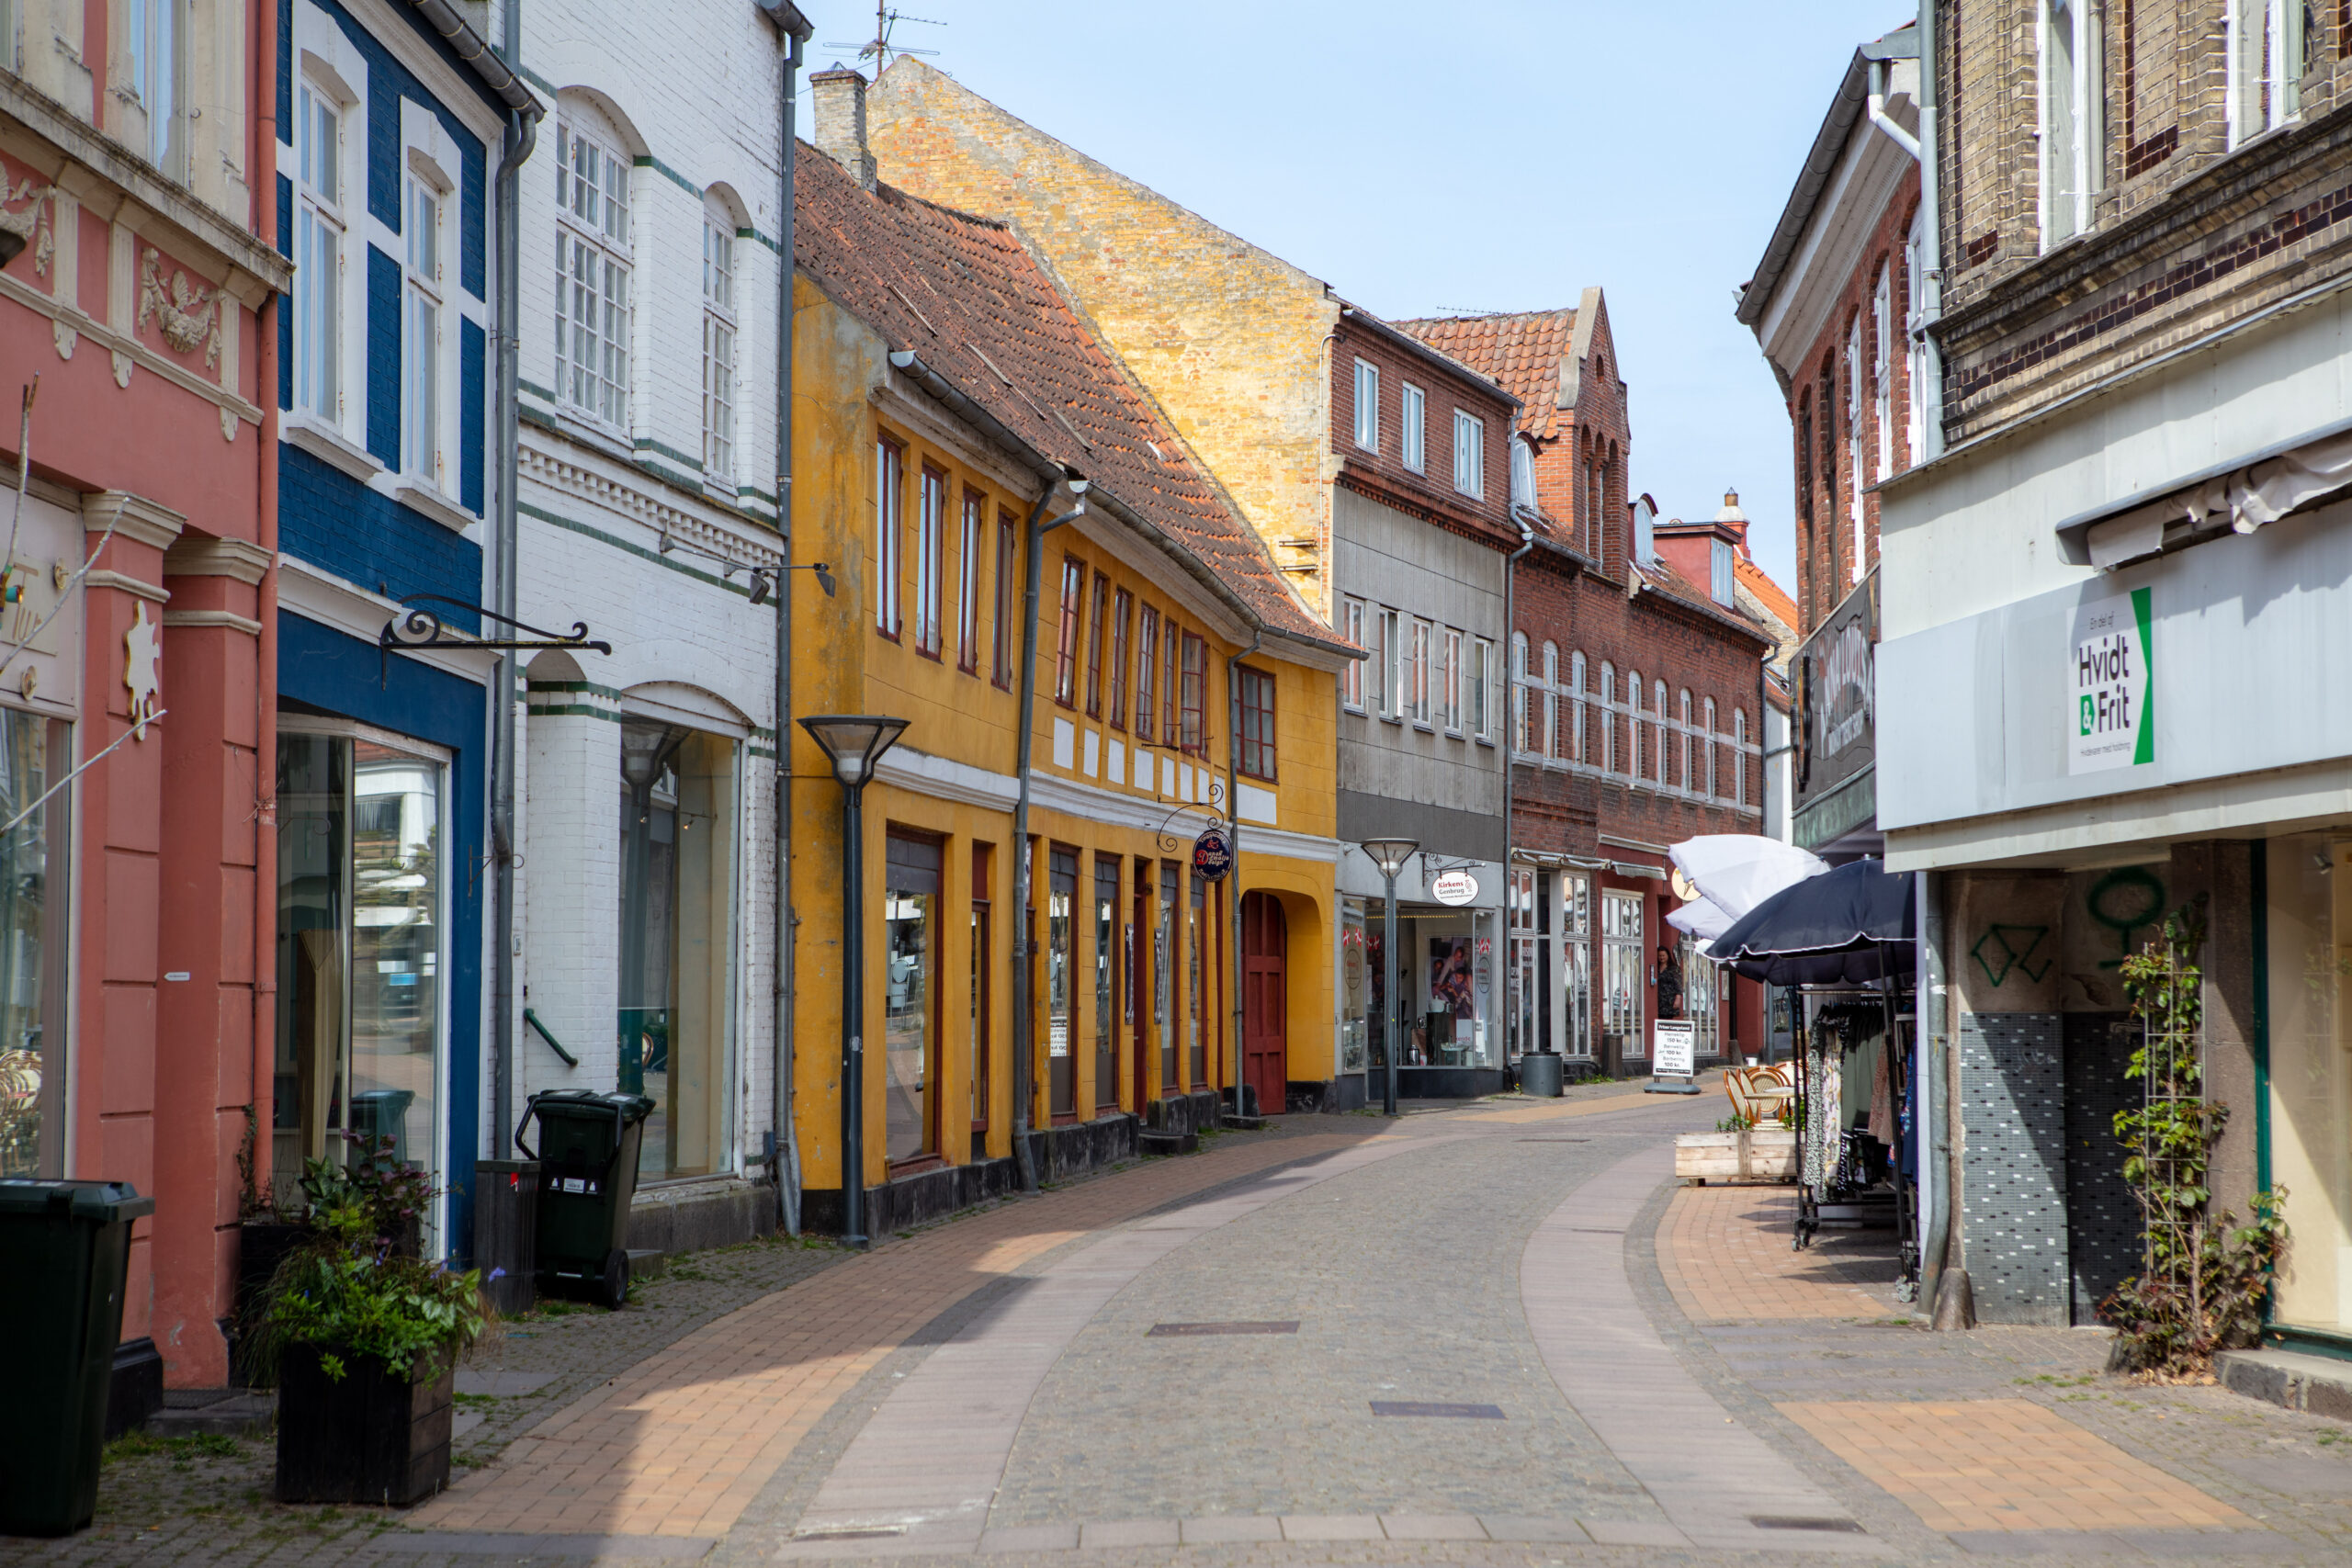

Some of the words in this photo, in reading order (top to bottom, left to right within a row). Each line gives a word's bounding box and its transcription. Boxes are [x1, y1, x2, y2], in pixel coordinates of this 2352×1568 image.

[2078, 634, 2130, 688] Hvidt
[2082, 699, 2093, 731] &
[2098, 682, 2131, 733] Frit
